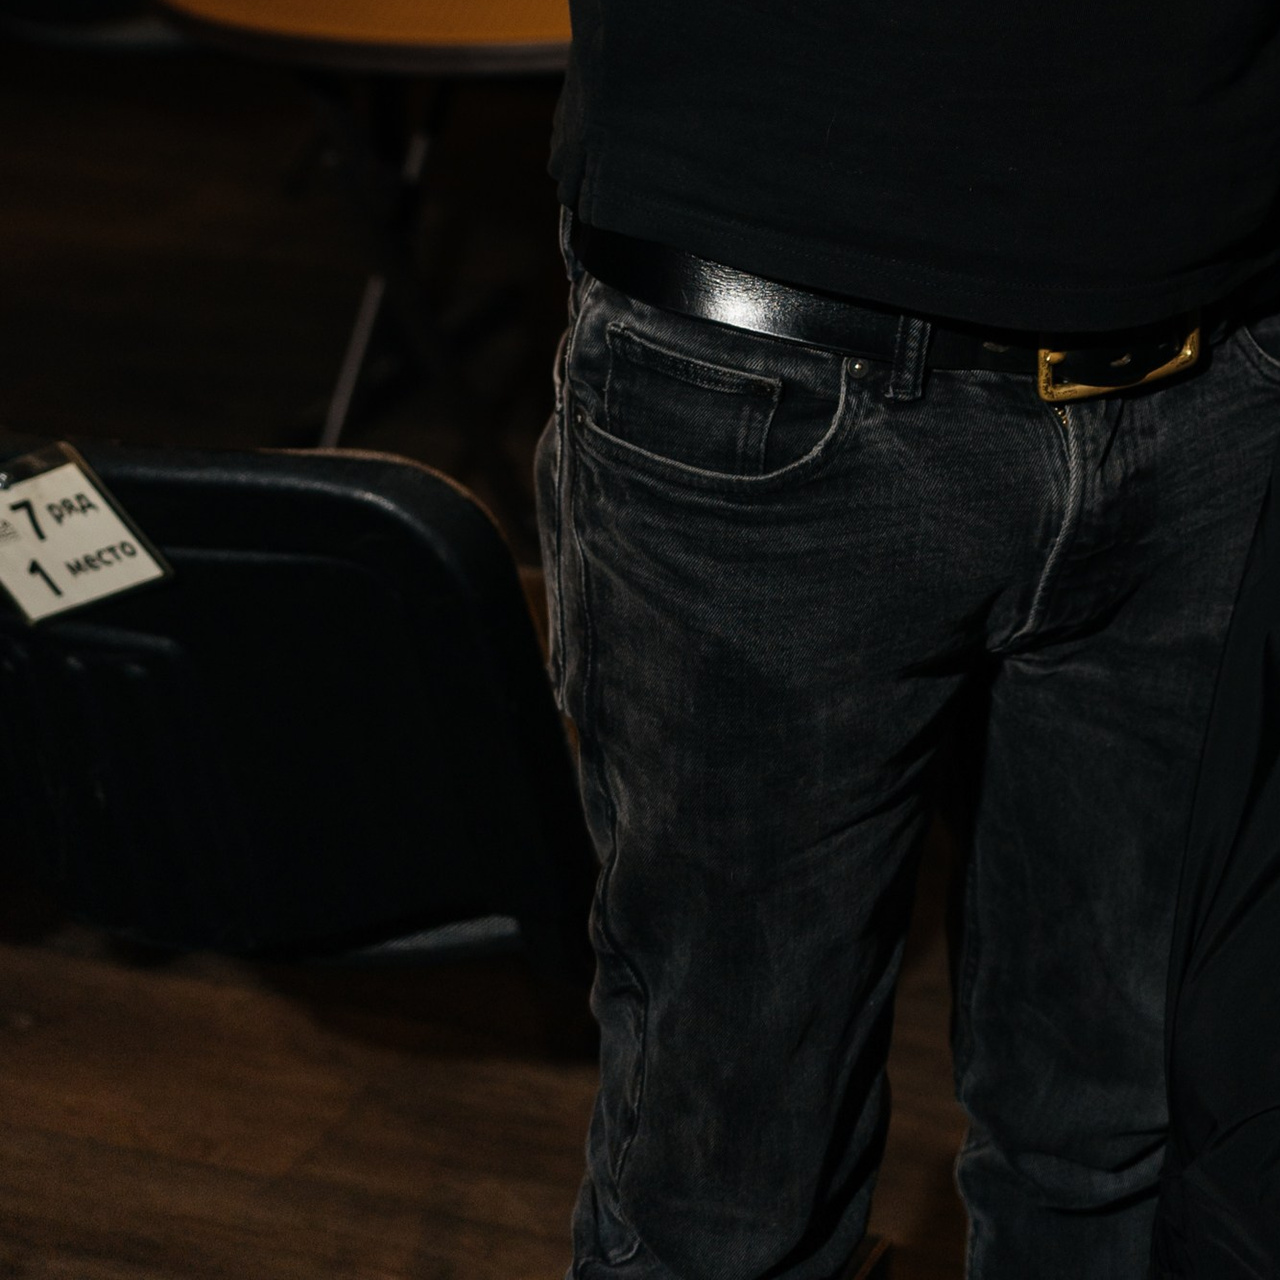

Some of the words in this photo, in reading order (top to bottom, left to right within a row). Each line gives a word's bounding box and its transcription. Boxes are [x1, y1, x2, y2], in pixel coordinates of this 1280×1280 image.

[10, 499, 46, 541] 7
[46, 493, 98, 525] ряд
[28, 558, 63, 597] 1
[65, 541, 138, 576] место
